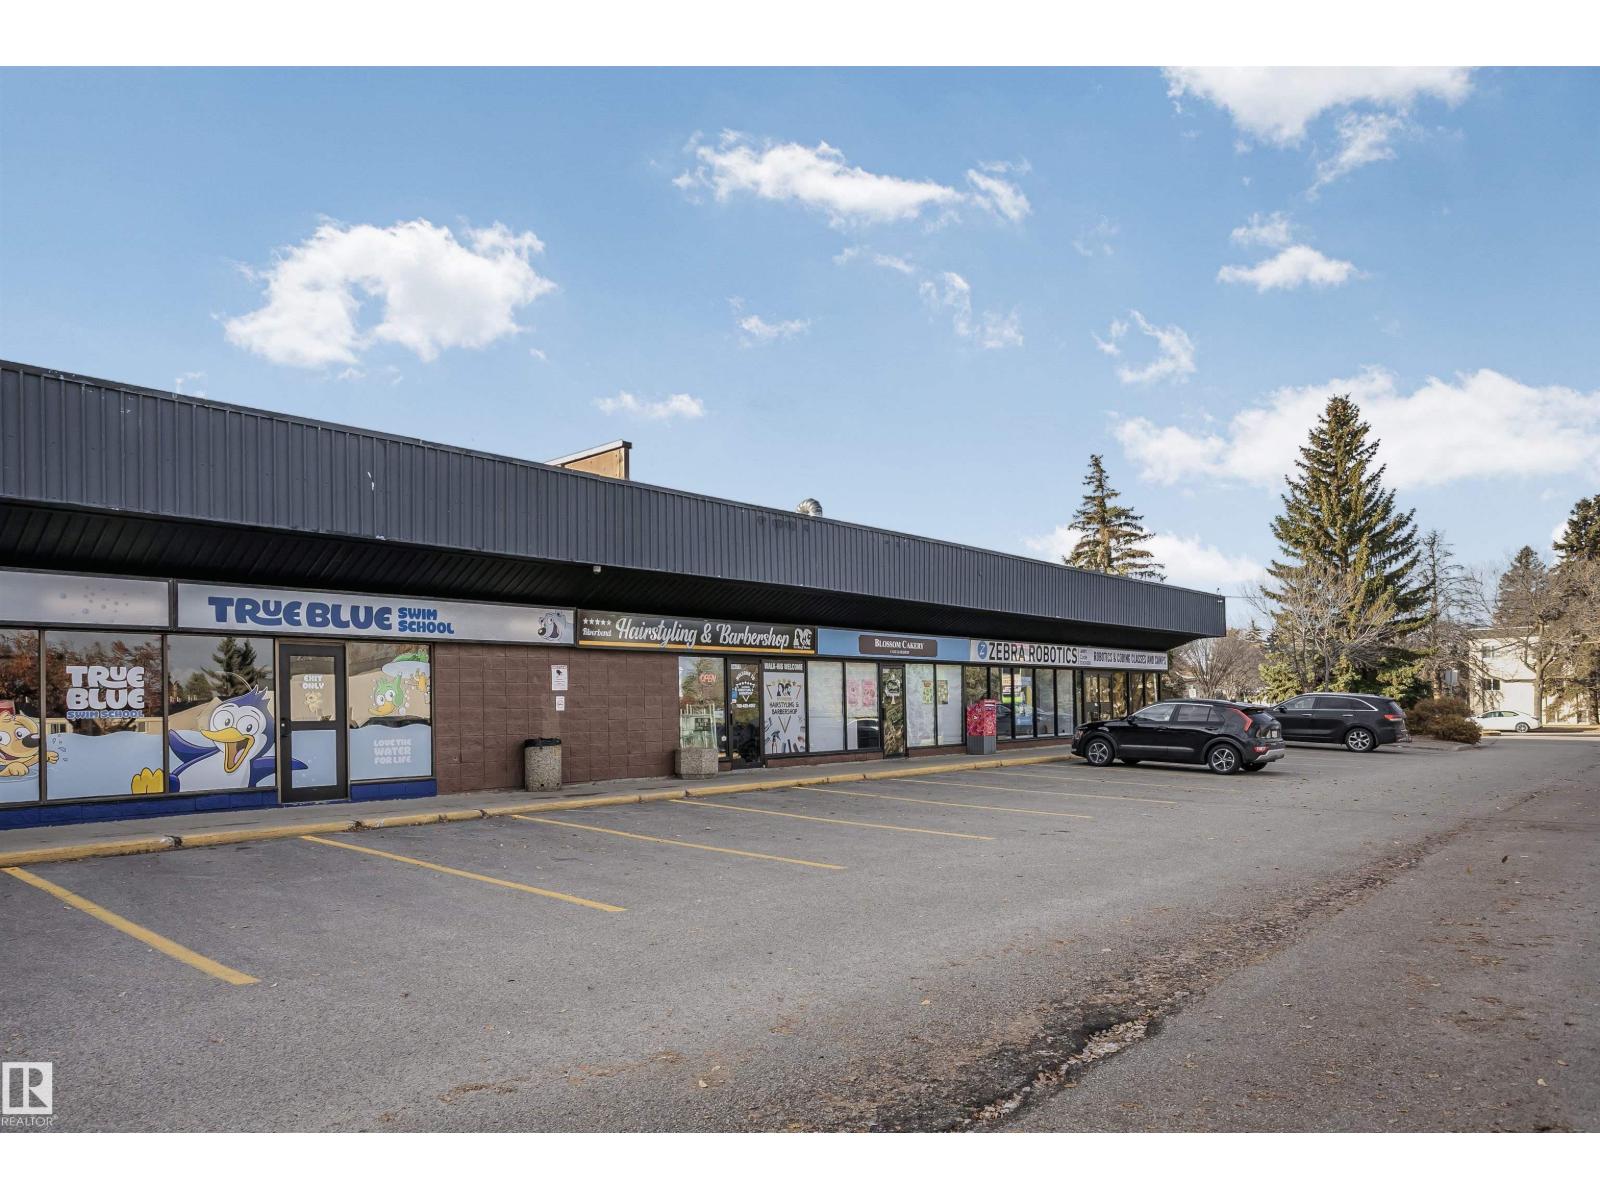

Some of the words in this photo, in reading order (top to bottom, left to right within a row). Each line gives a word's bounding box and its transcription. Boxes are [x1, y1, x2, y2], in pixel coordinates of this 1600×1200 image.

[208, 596, 302, 626] TRUE
[306, 602, 392, 630] BLUE
[398, 606, 437, 620] SWIM
[398, 620, 455, 634] SCHOOL
[615, 617, 698, 648] Hairstyling
[700, 623, 712, 643] &
[716, 624, 789, 653] Barbershop
[989, 642, 1026, 662] ZEBRA
[1029, 643, 1078, 664] ROBOTICS
[66, 665, 145, 688] TRUE
[699, 672, 717, 683] OPEN
[66, 687, 145, 709] BLUE
[67, 710, 99, 720] SWIM
[100, 710, 144, 719] SCHOOL
[374, 746, 411, 756] WATER
[374, 756, 392, 764] FOR
